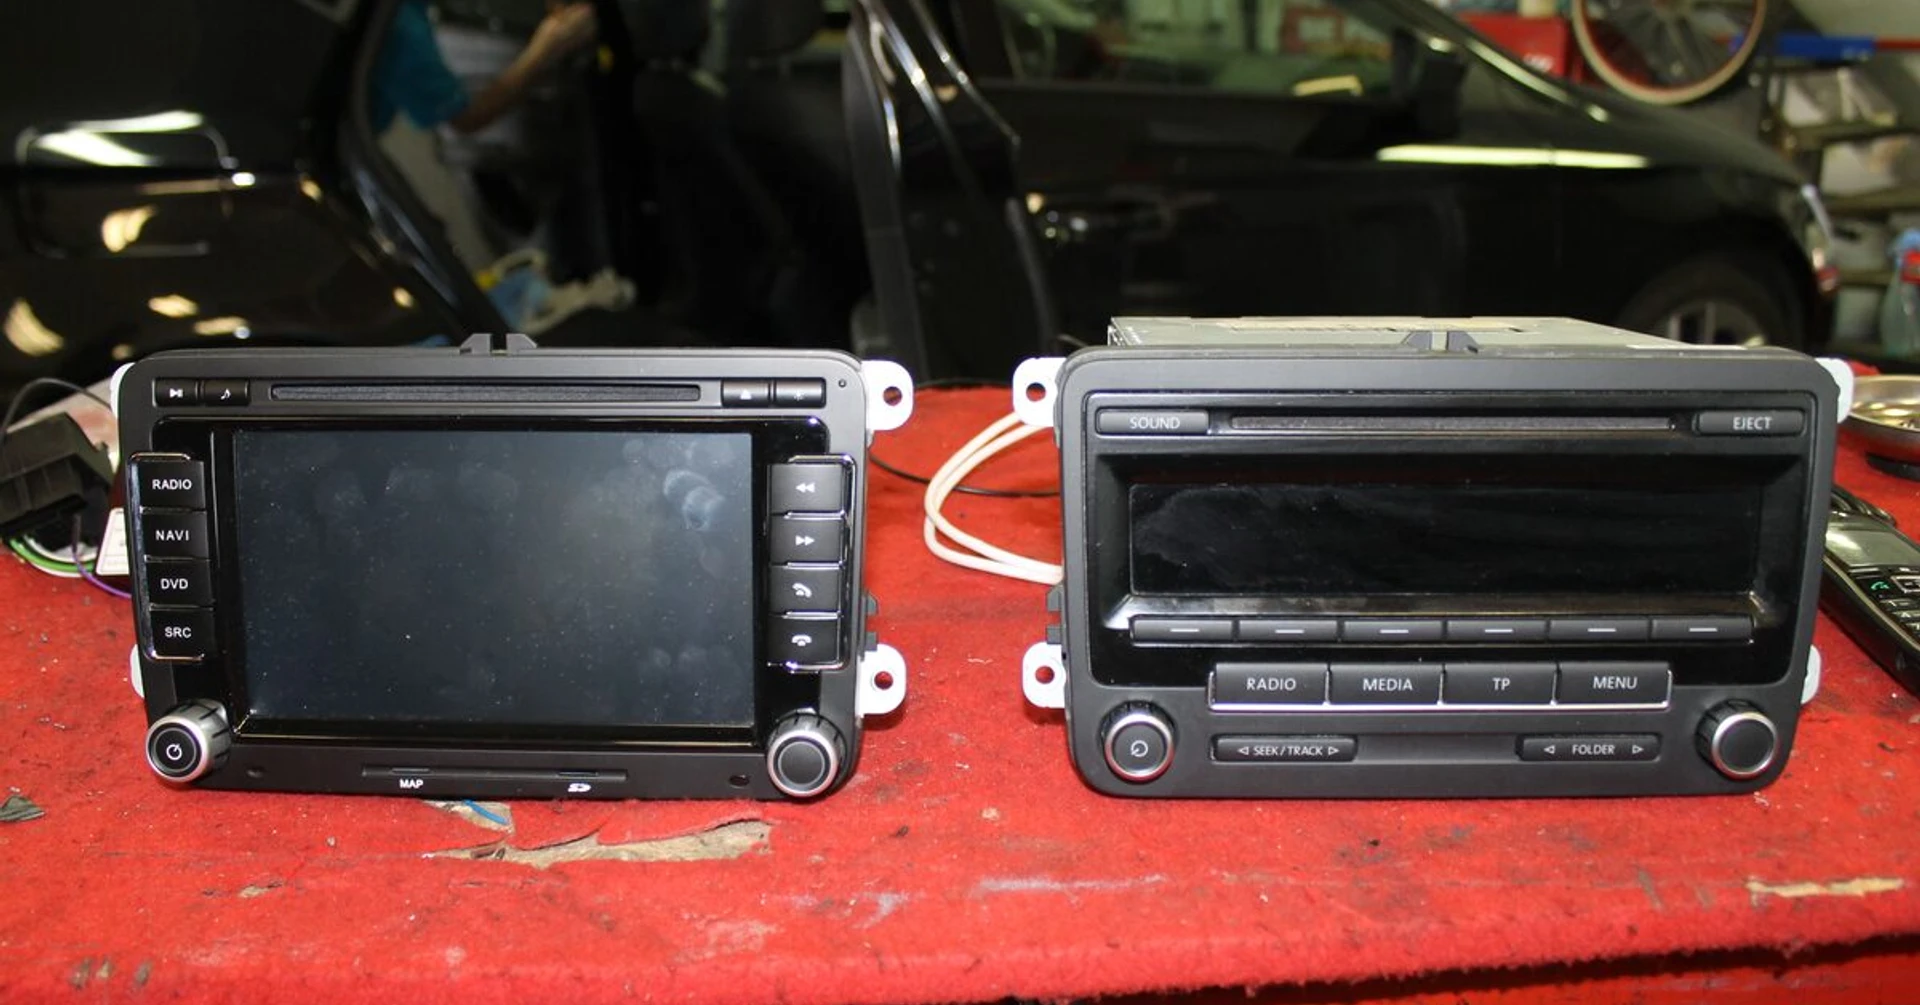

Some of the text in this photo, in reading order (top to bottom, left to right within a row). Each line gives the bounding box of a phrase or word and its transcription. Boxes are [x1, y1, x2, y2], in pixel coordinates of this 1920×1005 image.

[1129, 416, 1181, 429] SOUND
[1733, 416, 1772, 430] EJECT
[152, 478, 192, 491] RADIO
[155, 529, 189, 541] NAVI
[160, 577, 189, 590] DVD
[164, 626, 192, 639] SRC
[1246, 677, 1297, 691] RADIO
[1362, 678, 1413, 691] MEDIA
[1493, 677, 1511, 691] TP
[1592, 676, 1638, 690] MENU
[1572, 744, 1615, 755] FOLDER
[399, 778, 424, 790] MAP
